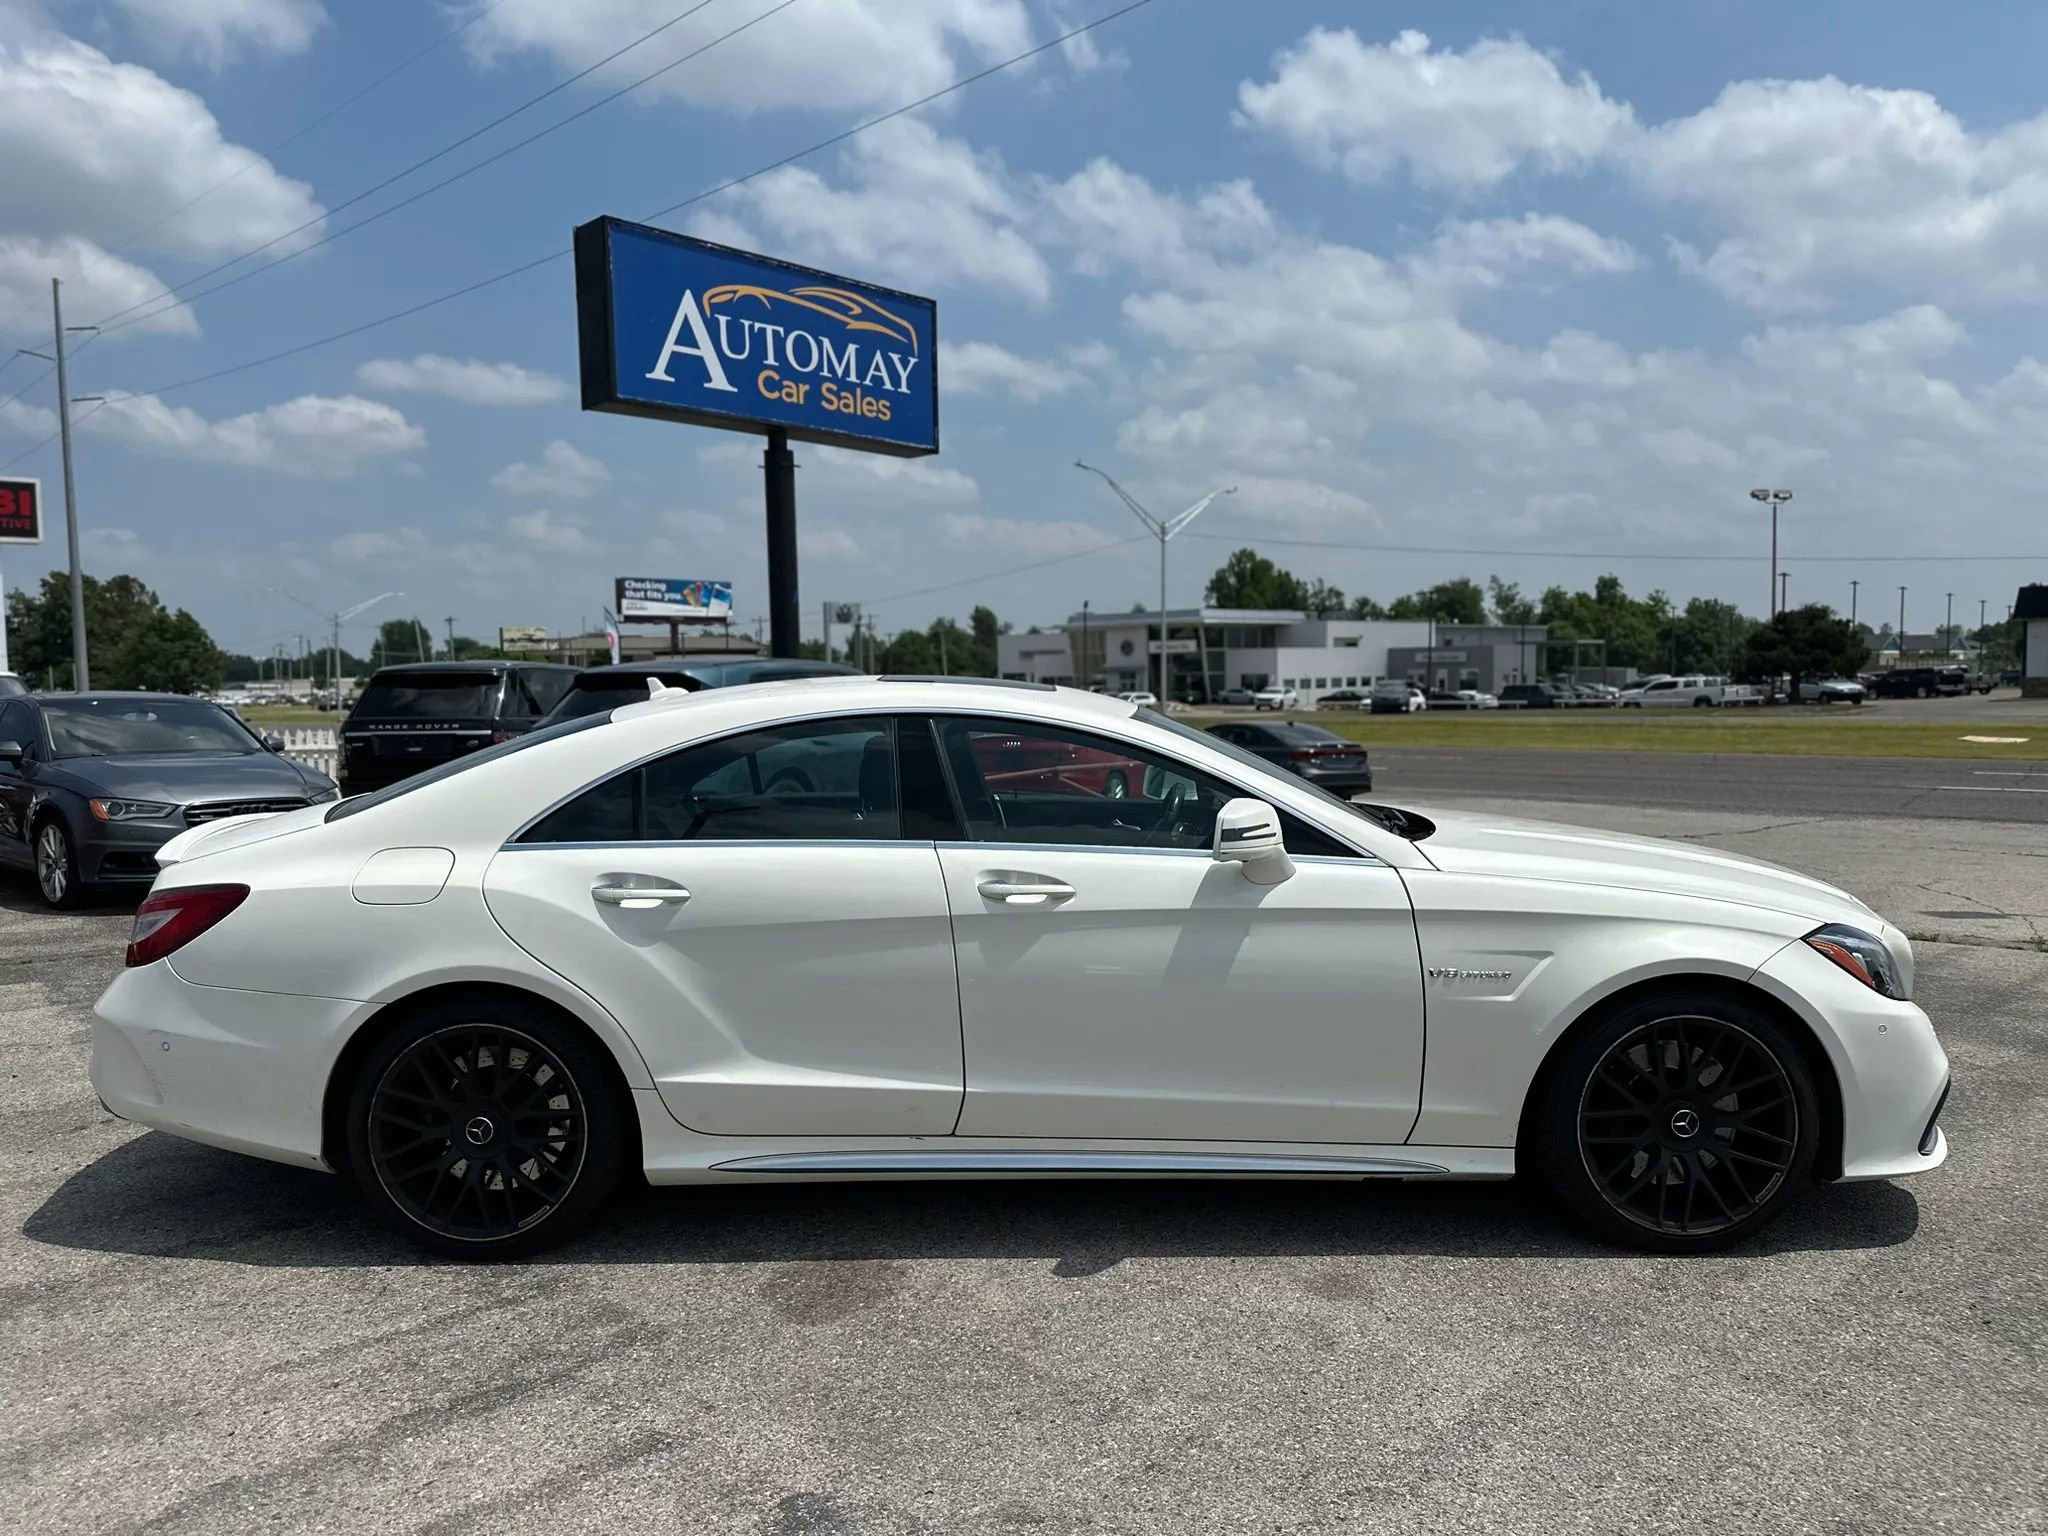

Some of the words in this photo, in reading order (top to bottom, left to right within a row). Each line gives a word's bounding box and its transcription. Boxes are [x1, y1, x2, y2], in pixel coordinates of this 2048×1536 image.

[645, 288, 918, 394] AUTOMAY
[757, 370, 810, 405] Car
[820, 382, 891, 421] Sales
[625, 580, 667, 591] Checking
[625, 590, 645, 599] that
[647, 590, 662, 600] fits
[1428, 967, 1459, 979] V8
